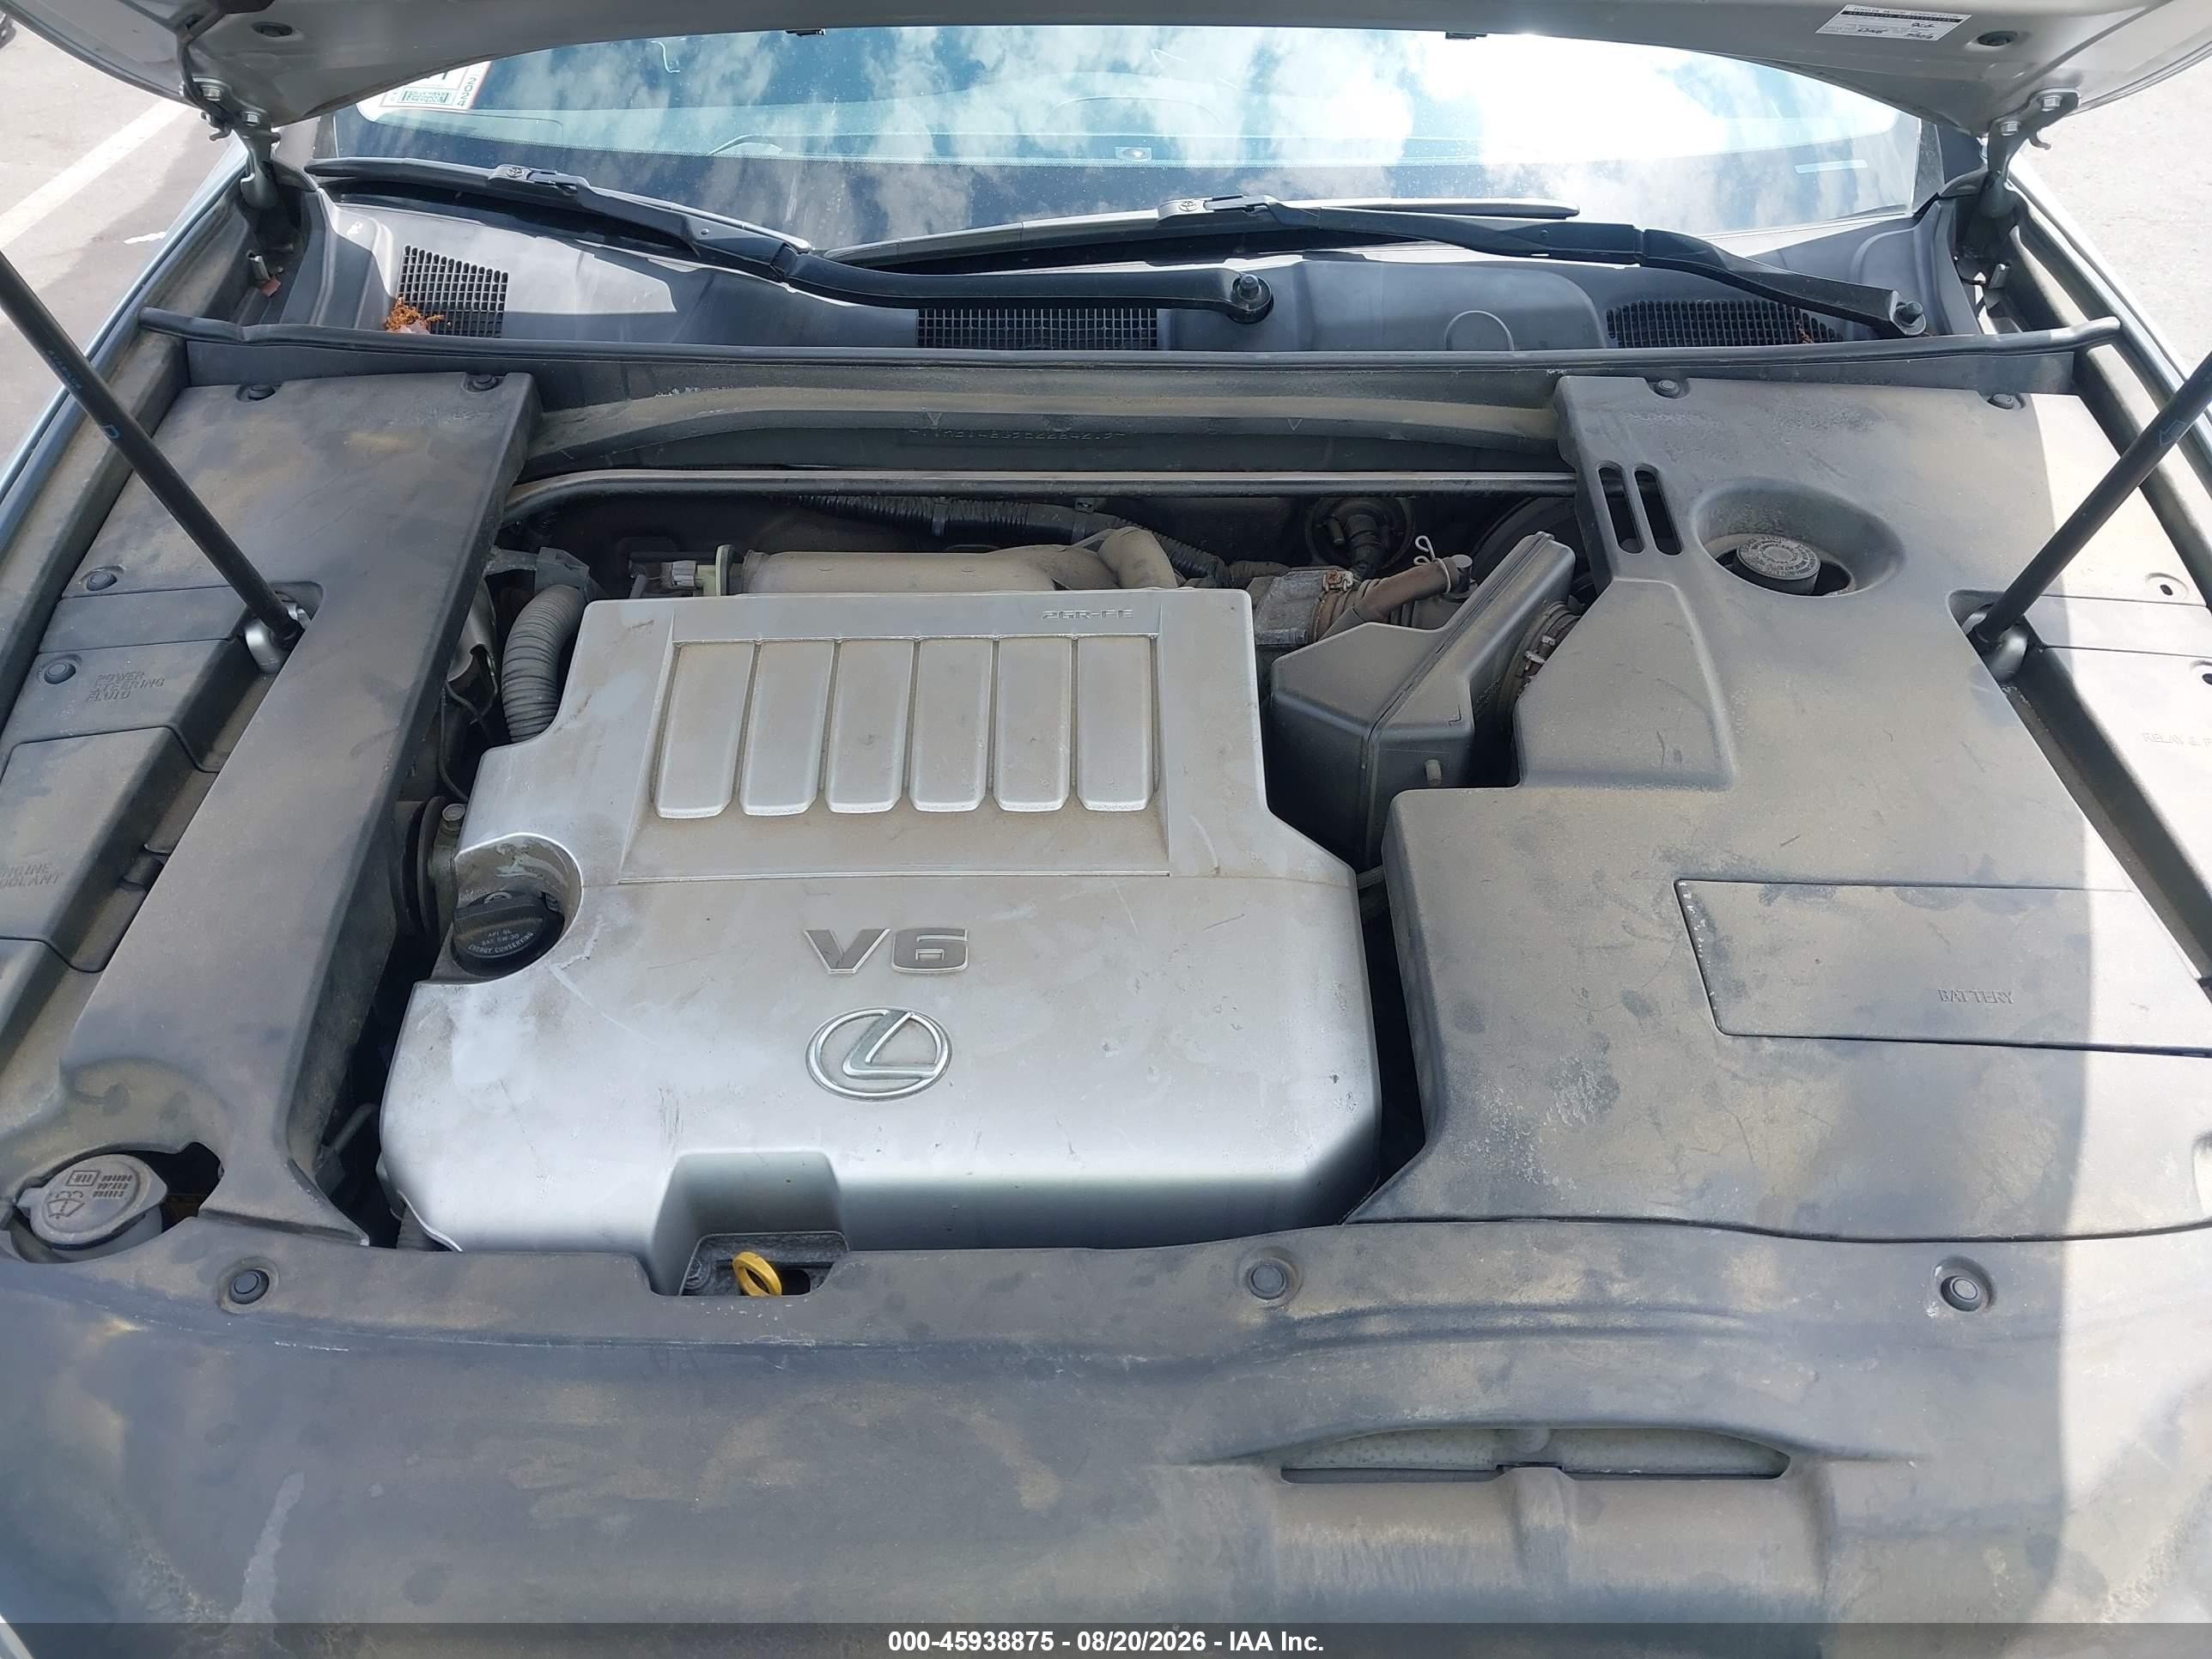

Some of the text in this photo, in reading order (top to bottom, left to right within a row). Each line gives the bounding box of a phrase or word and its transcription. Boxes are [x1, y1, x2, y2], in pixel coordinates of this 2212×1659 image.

[457, 76, 477, 107] 2024
[1042, 609, 1135, 620] 2GR-FE
[96, 671, 145, 683] POWER
[90, 678, 165, 693] STEERING
[85, 689, 131, 702] FLUID
[0, 872, 64, 890] OOLANT
[803, 927, 969, 975] V6
[1937, 988, 2014, 1005] BATTERY
